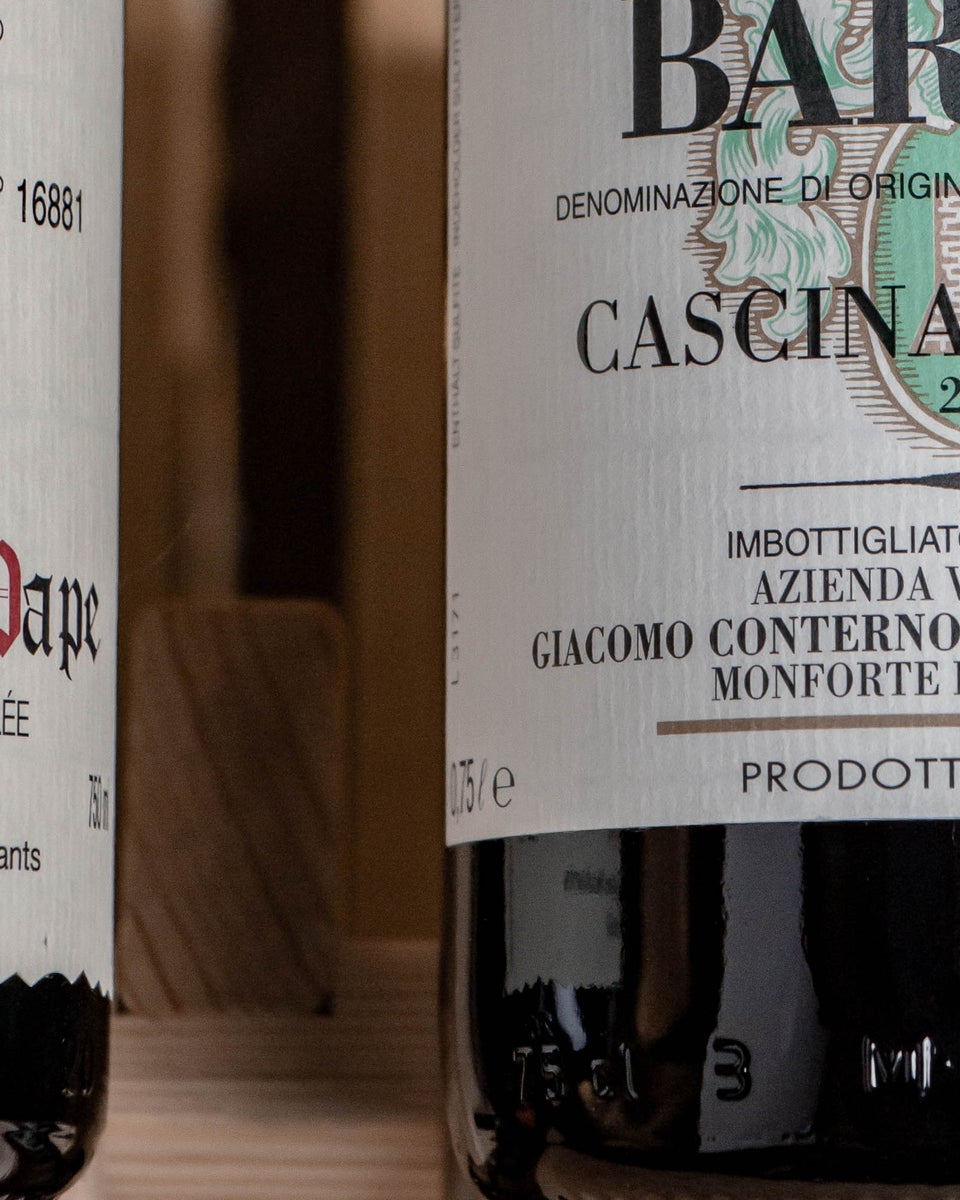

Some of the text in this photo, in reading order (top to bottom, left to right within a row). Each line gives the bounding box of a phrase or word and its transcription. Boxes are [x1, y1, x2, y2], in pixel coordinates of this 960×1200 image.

[17, 177, 83, 233] 16881
[556, 176, 783, 221] DENOMINAZIONE
[801, 175, 830, 202] DI
[750, 566, 935, 605] AZIENDA
[532, 620, 694, 670] GIACOMO
[711, 660, 940, 702] MONFORTE
[0, 690, 30, 737] ÉE
